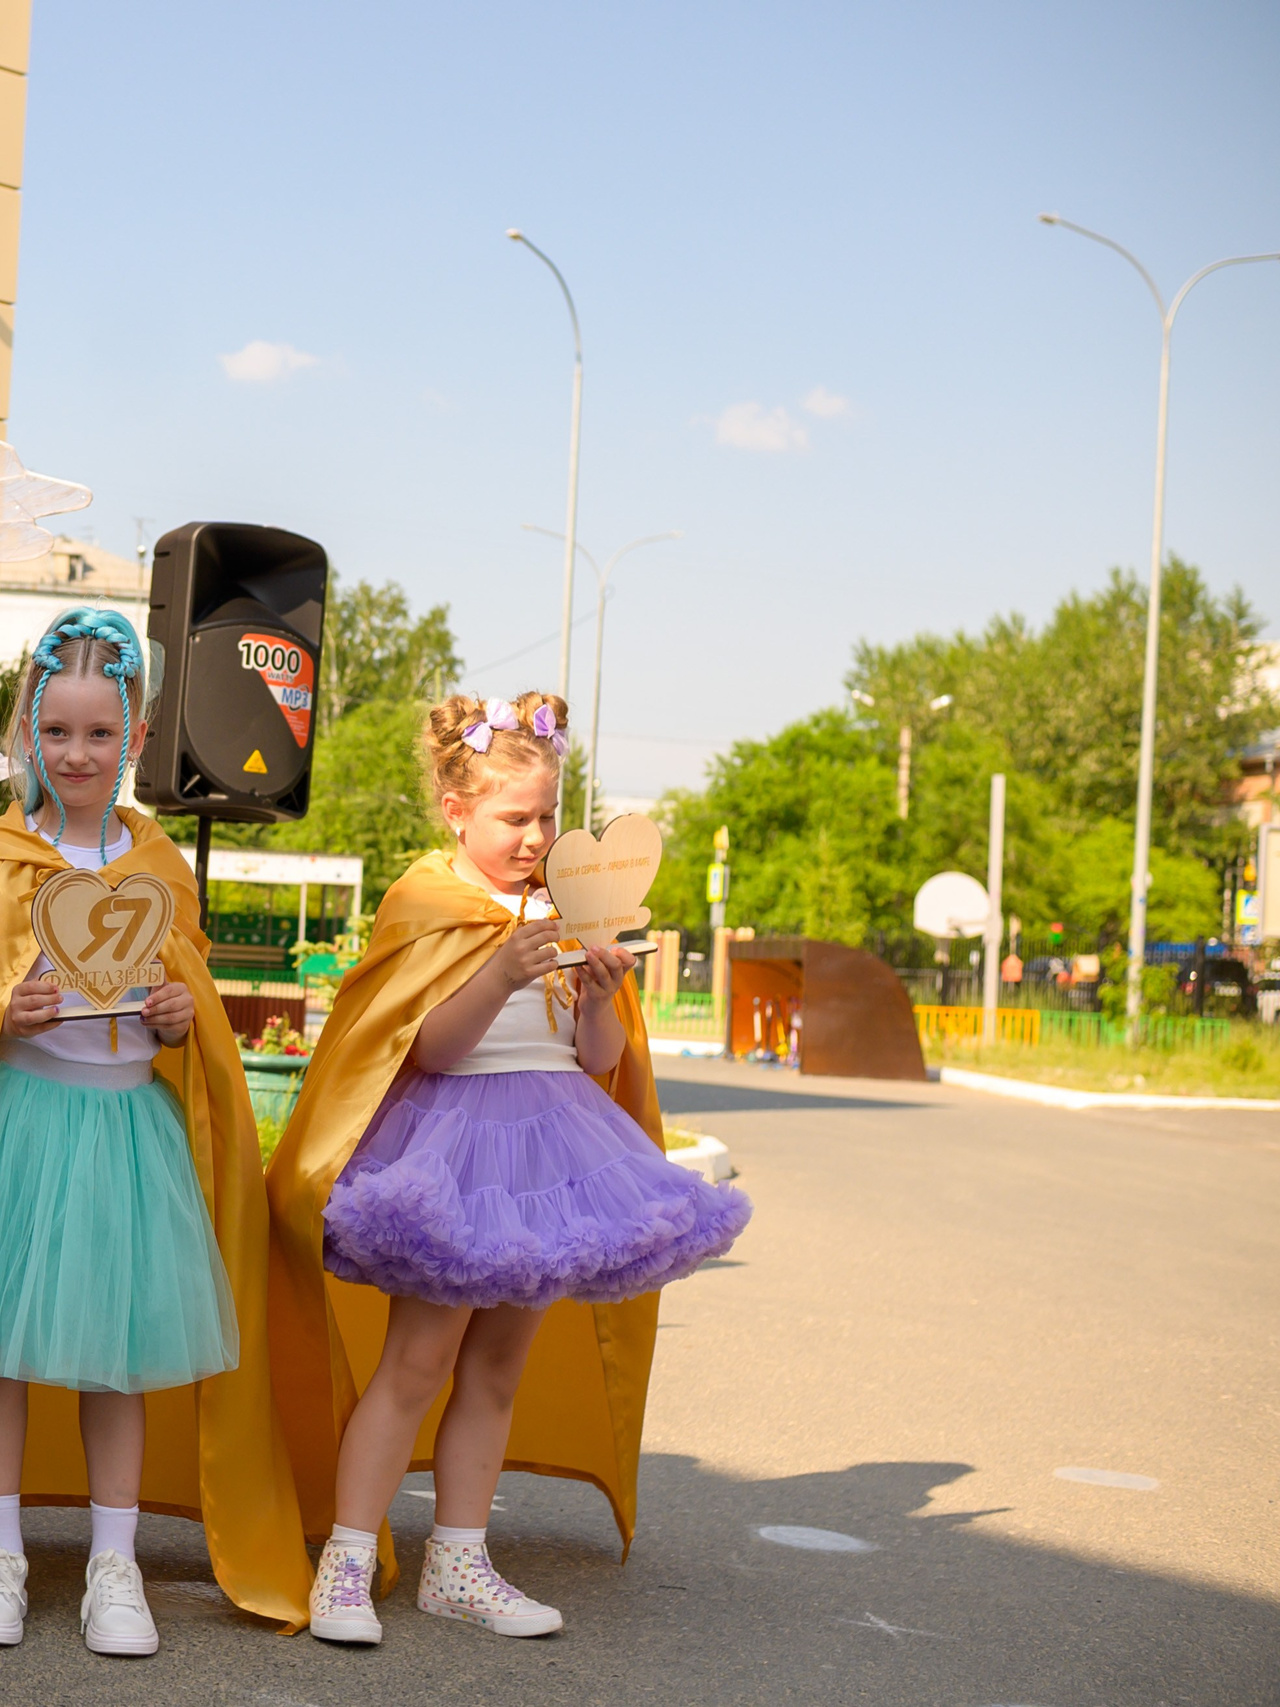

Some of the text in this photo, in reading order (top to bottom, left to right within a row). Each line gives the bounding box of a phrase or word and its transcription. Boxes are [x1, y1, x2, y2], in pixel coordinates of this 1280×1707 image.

[240, 641, 301, 675] 1000
[267, 671, 295, 684] WATTS
[281, 687, 309, 707] MP3
[43, 966, 162, 990] ФАНТАЗЁРЫ
